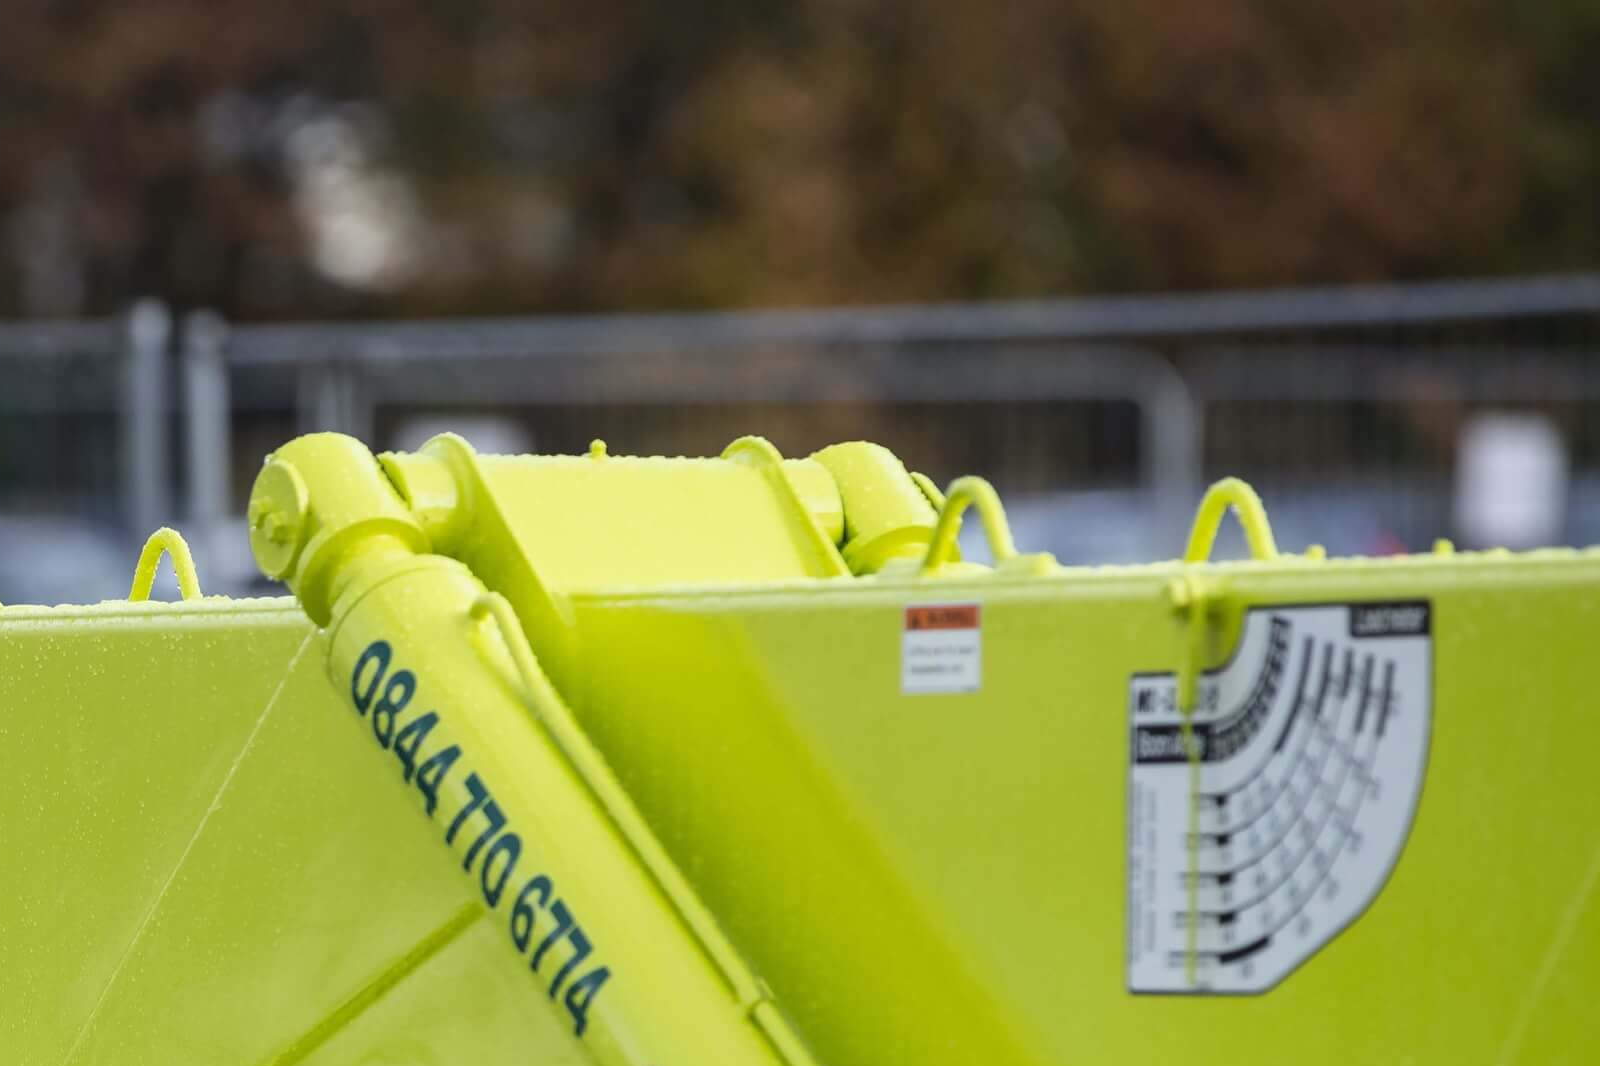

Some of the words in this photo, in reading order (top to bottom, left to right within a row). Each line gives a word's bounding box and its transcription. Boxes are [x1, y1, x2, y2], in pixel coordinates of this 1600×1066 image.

[352, 640, 463, 817] 0844
[445, 772, 523, 909] 770
[510, 874, 611, 1039] 6774
